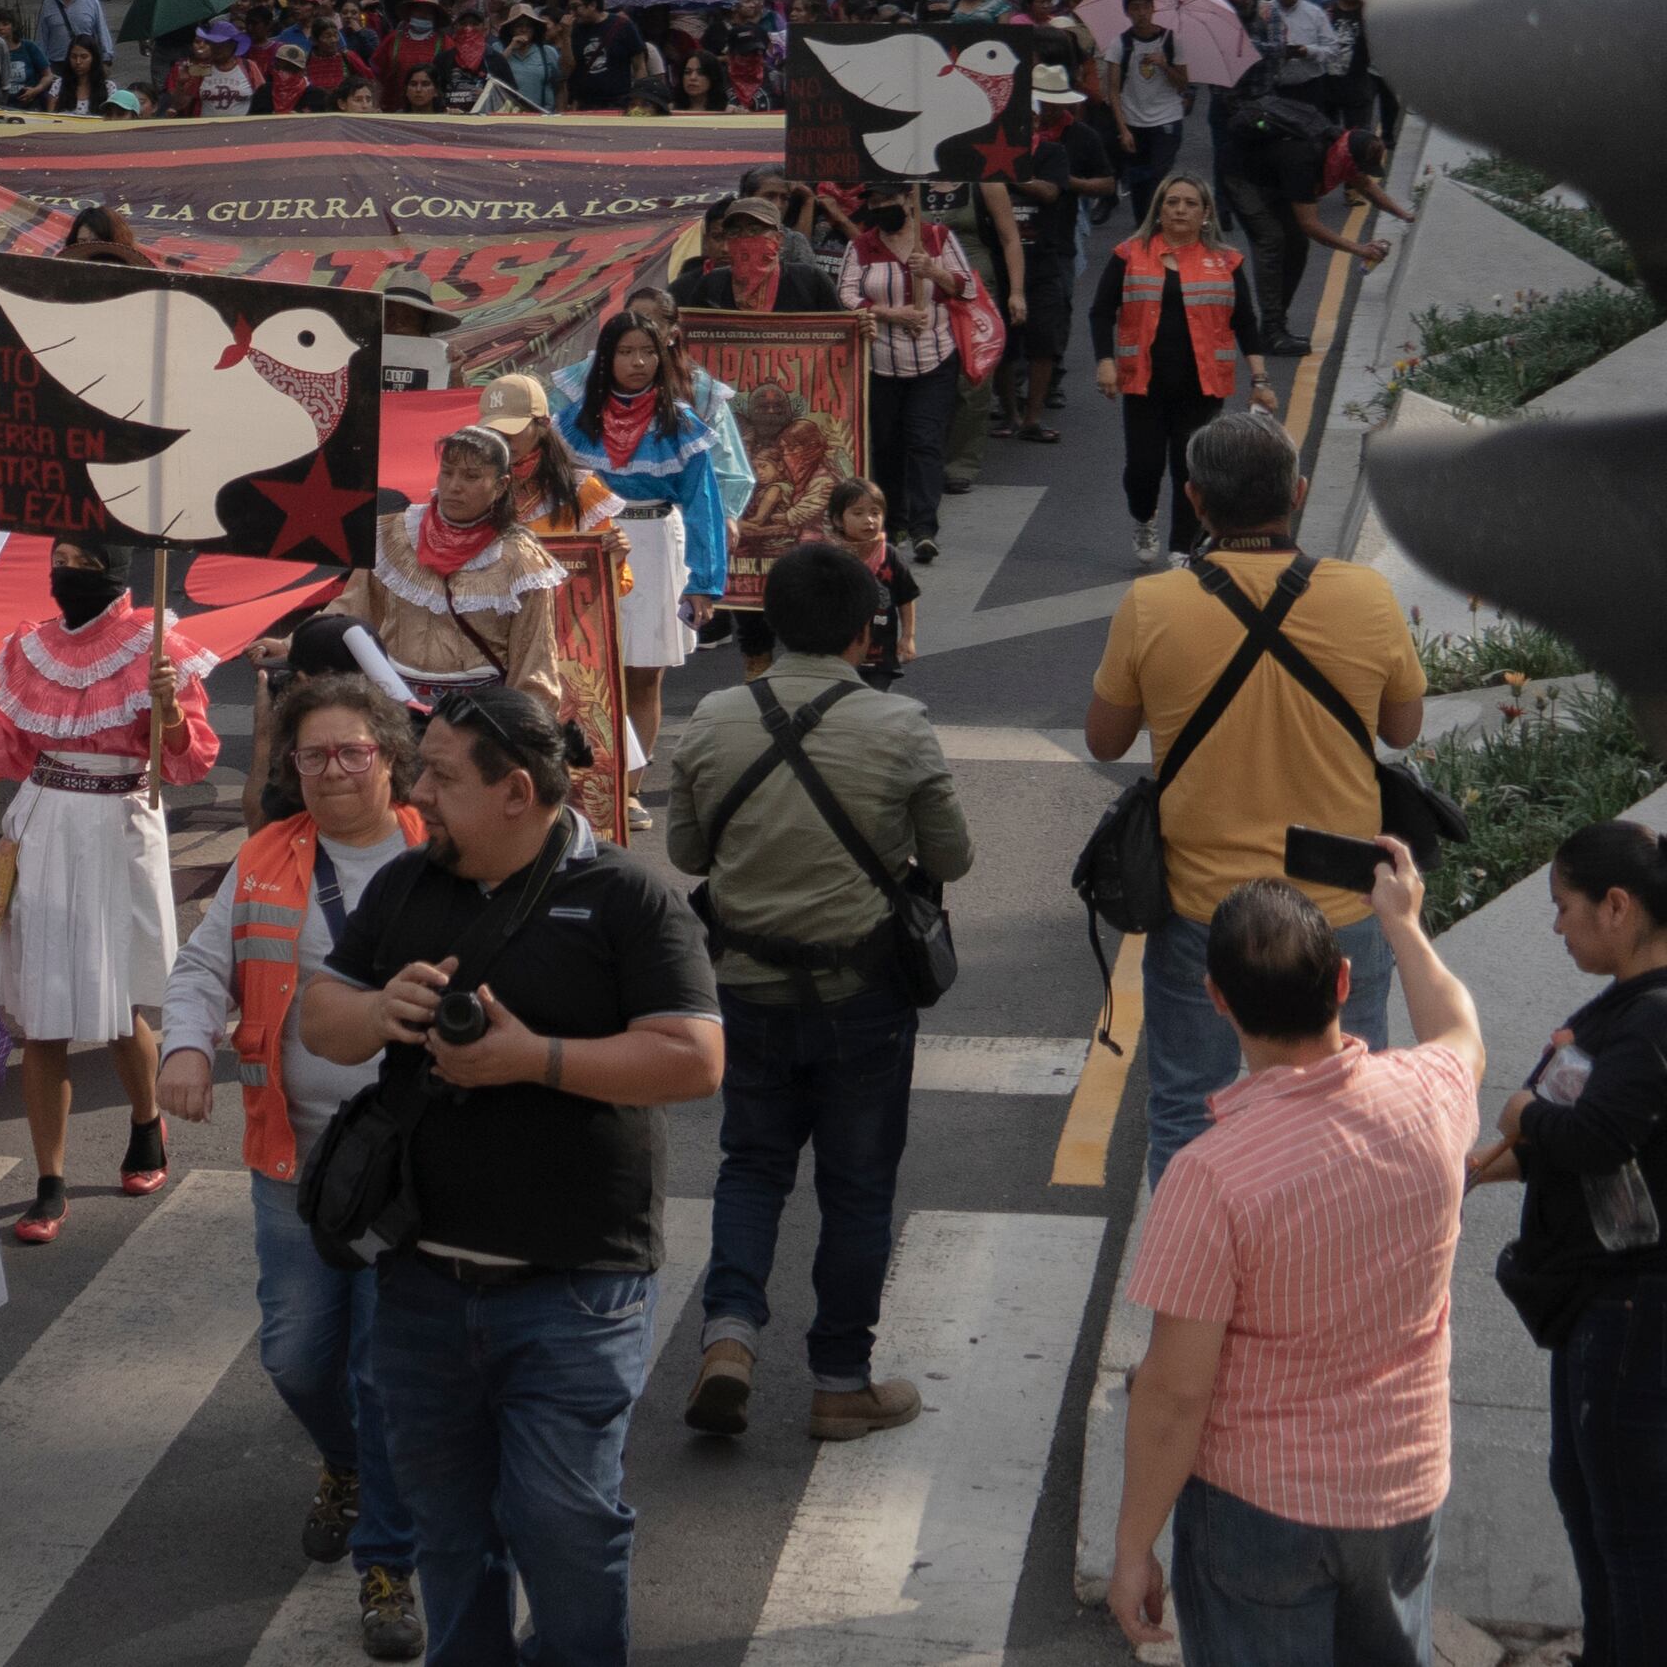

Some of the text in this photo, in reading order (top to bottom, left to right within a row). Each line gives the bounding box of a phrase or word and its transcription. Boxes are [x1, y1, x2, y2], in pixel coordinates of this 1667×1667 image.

[789, 77, 822, 98] NO
[144, 203, 195, 222] LA
[206, 196, 378, 224] GUERRA
[390, 194, 570, 224] CONTRA
[580, 198, 661, 217] LOS
[687, 330, 708, 339] ALTO
[715, 331, 727, 339] LA
[727, 331, 761, 339] GUERRA
[761, 332, 795, 340] CONTRA
[795, 332, 811, 340] LOS
[811, 332, 846, 340] PUEBLOS
[384, 369, 413, 383] ALTO
[65, 427, 106, 463] EN
[23, 489, 108, 533] EZLN
[1218, 536, 1272, 550] Canon
